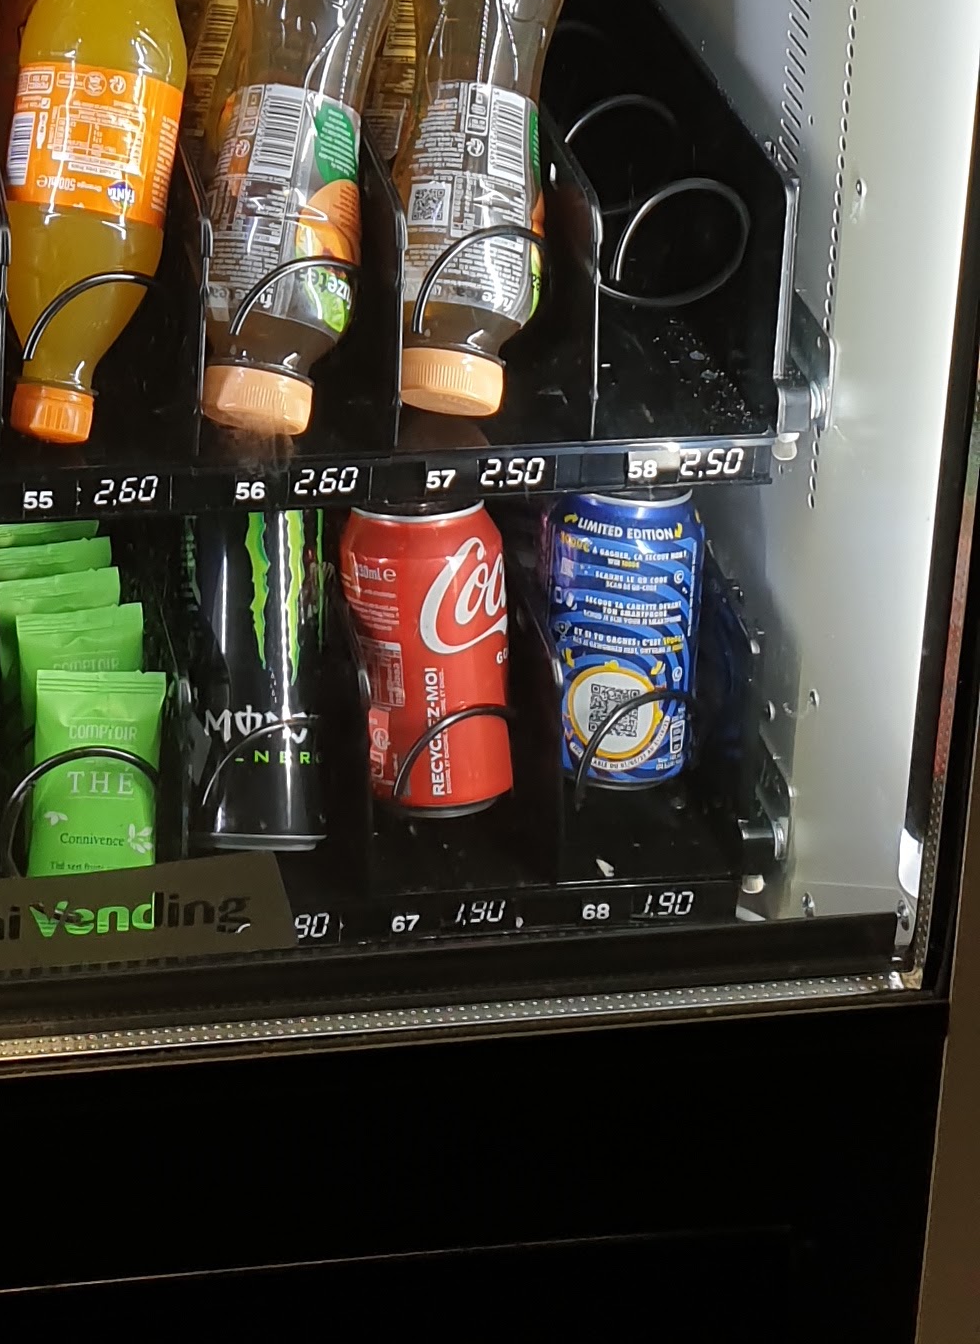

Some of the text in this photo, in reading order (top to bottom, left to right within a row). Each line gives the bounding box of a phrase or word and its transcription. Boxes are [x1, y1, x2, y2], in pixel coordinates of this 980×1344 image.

[479, 458, 546, 488] 2,50
[626, 458, 658, 479] 58
[679, 447, 745, 478] 2,50
[293, 466, 359, 497] 2,60
[426, 468, 457, 489] 57
[23, 490, 54, 509] 55
[93, 475, 160, 507] 2,60
[235, 481, 266, 501] 56
[578, 517, 674, 541] LIMITED EDITION
[69, 723, 138, 742] COMPTOIR
[66, 766, 134, 797] THÉ
[59, 829, 125, 847] Connivence
[27, 890, 251, 942] Vending
[455, 900, 507, 926] 1,90
[582, 902, 610, 921] 68
[643, 891, 695, 918] 1,90
[391, 913, 420, 932] 67
